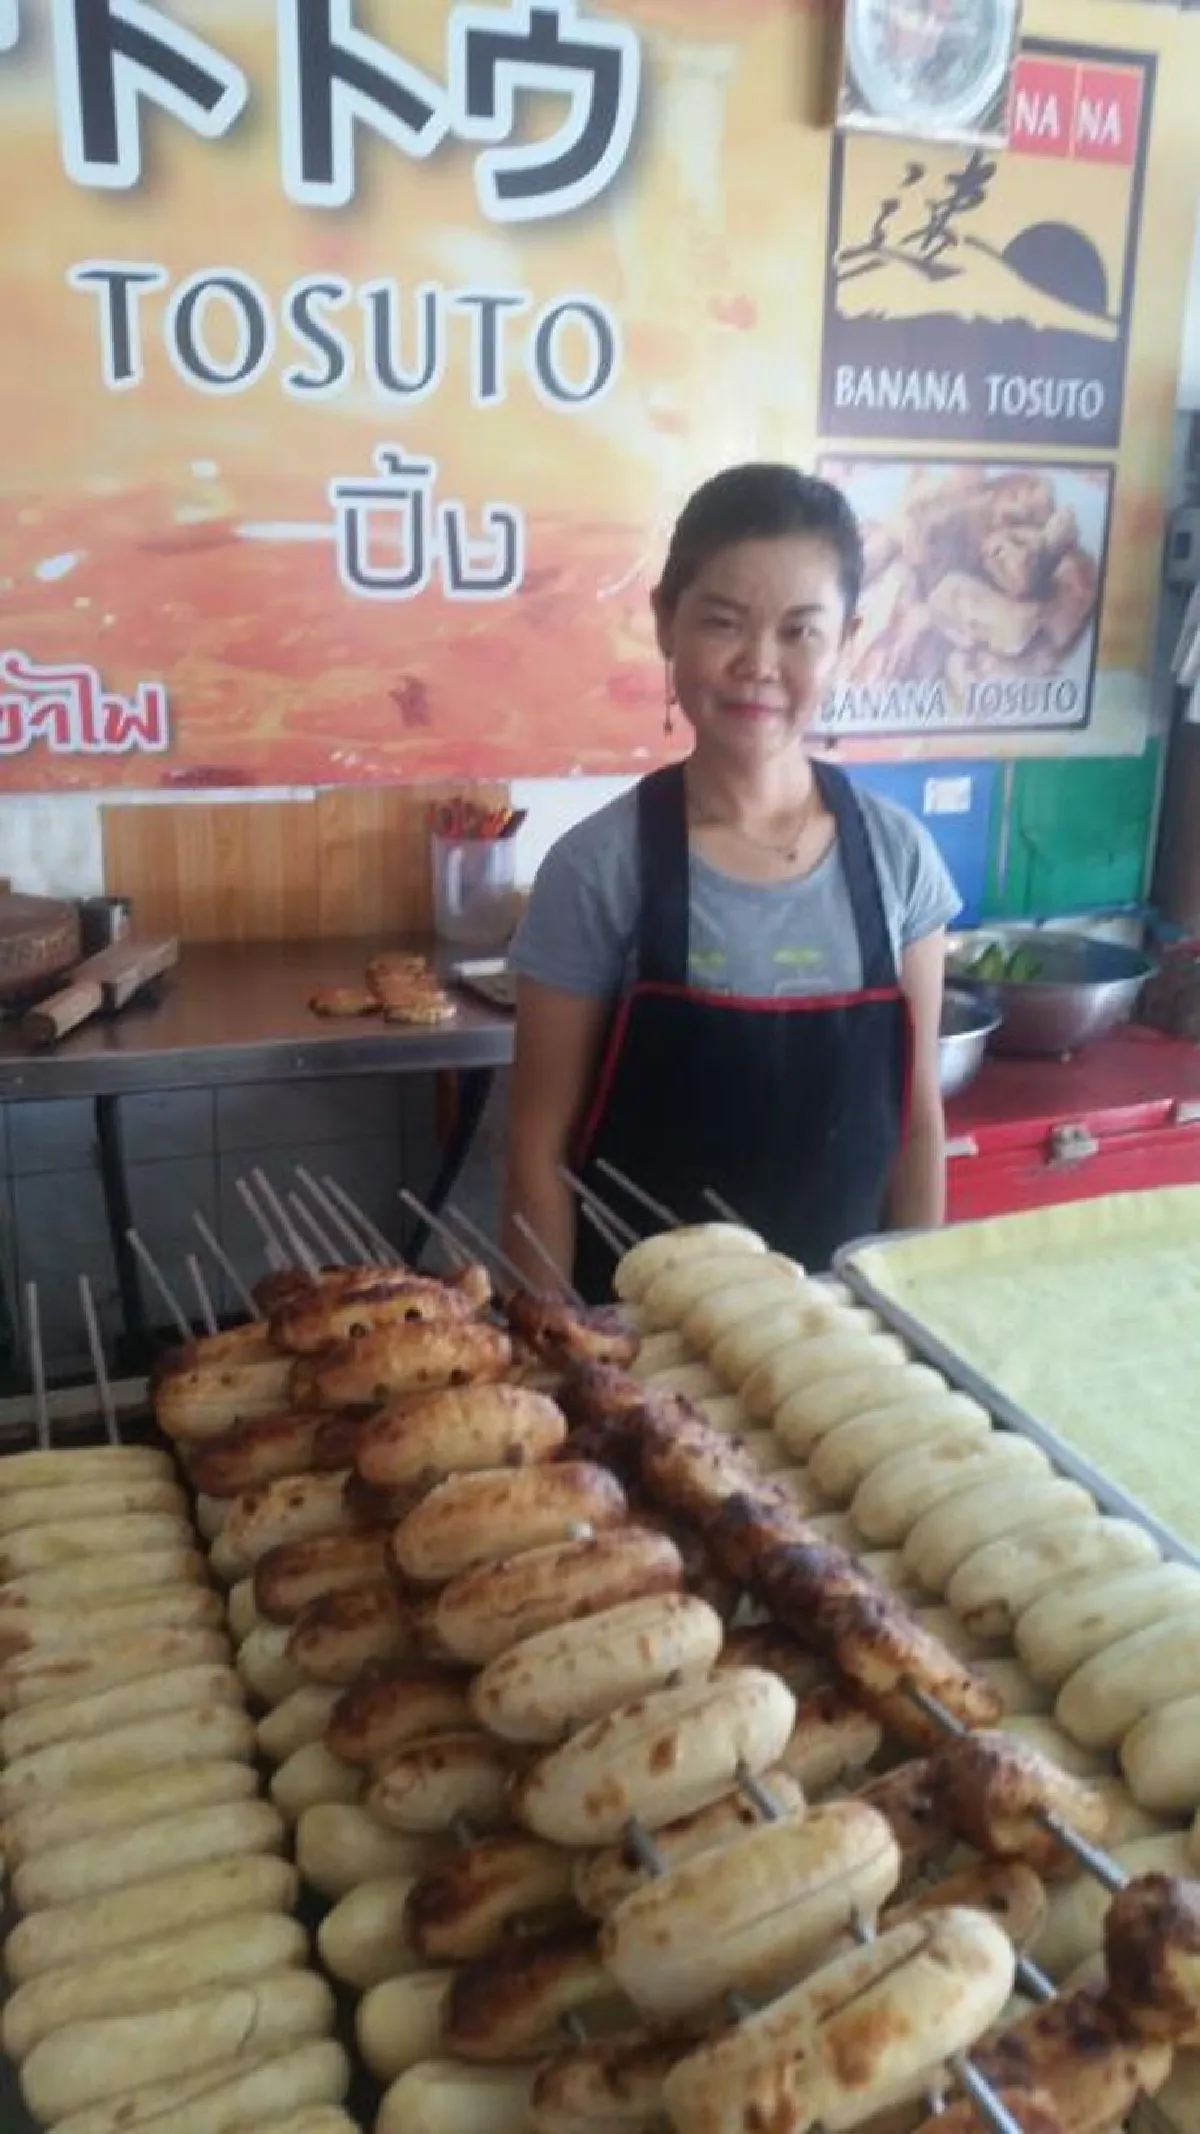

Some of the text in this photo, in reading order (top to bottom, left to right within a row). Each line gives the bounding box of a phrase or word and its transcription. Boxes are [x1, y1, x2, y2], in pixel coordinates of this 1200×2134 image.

[0, 0, 636, 212] トトウ
[72, 265, 617, 405] TOSUTO
[834, 364, 1105, 420] BANANA TOSUTO
[333, 449, 521, 593] ปิ้ง
[963, 678, 1080, 717] TOSUTO
